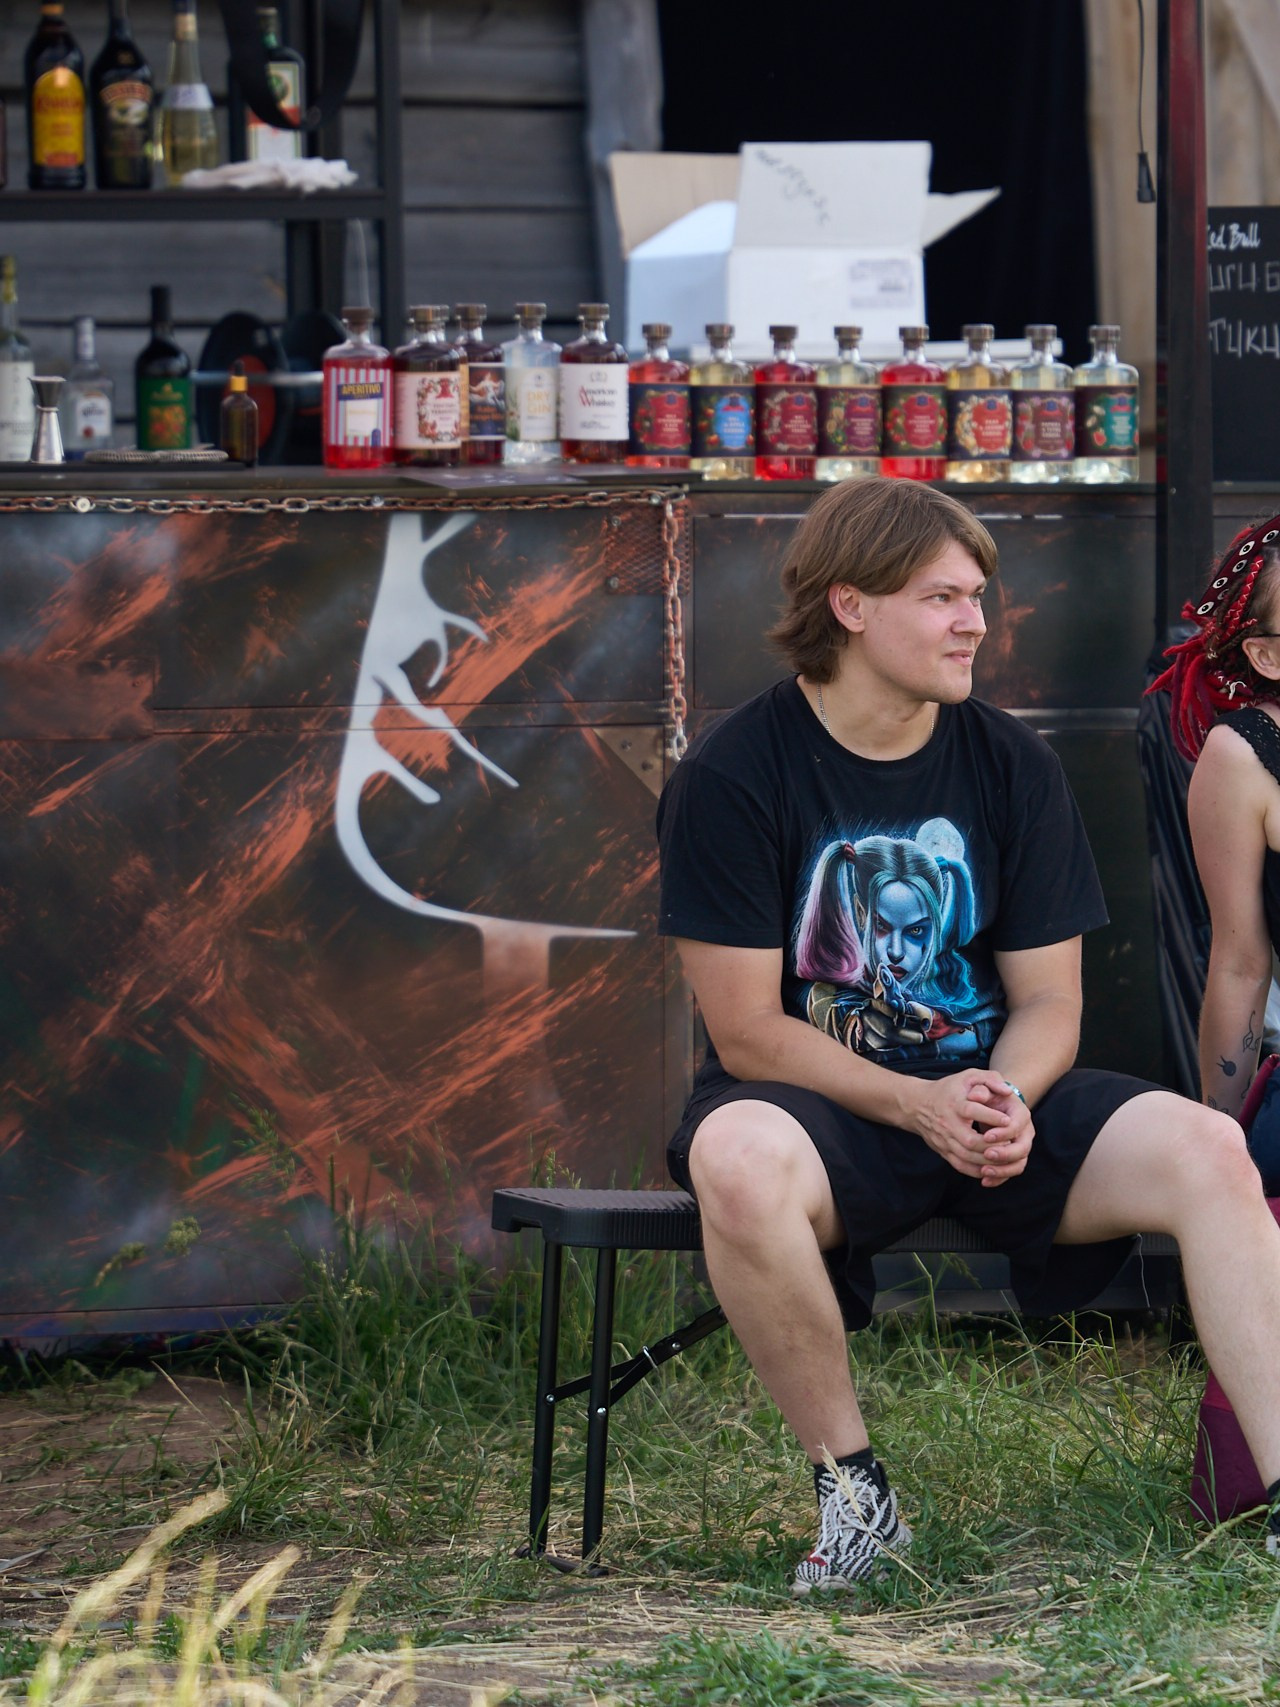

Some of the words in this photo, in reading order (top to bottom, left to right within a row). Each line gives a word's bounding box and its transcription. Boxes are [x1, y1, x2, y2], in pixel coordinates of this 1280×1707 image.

[1207, 223, 1227, 250] ed
[1229, 222, 1260, 251] Bull
[341, 383, 381, 395] APERITIVO
[527, 392, 550, 403] DRY
[527, 403, 550, 414] GIN
